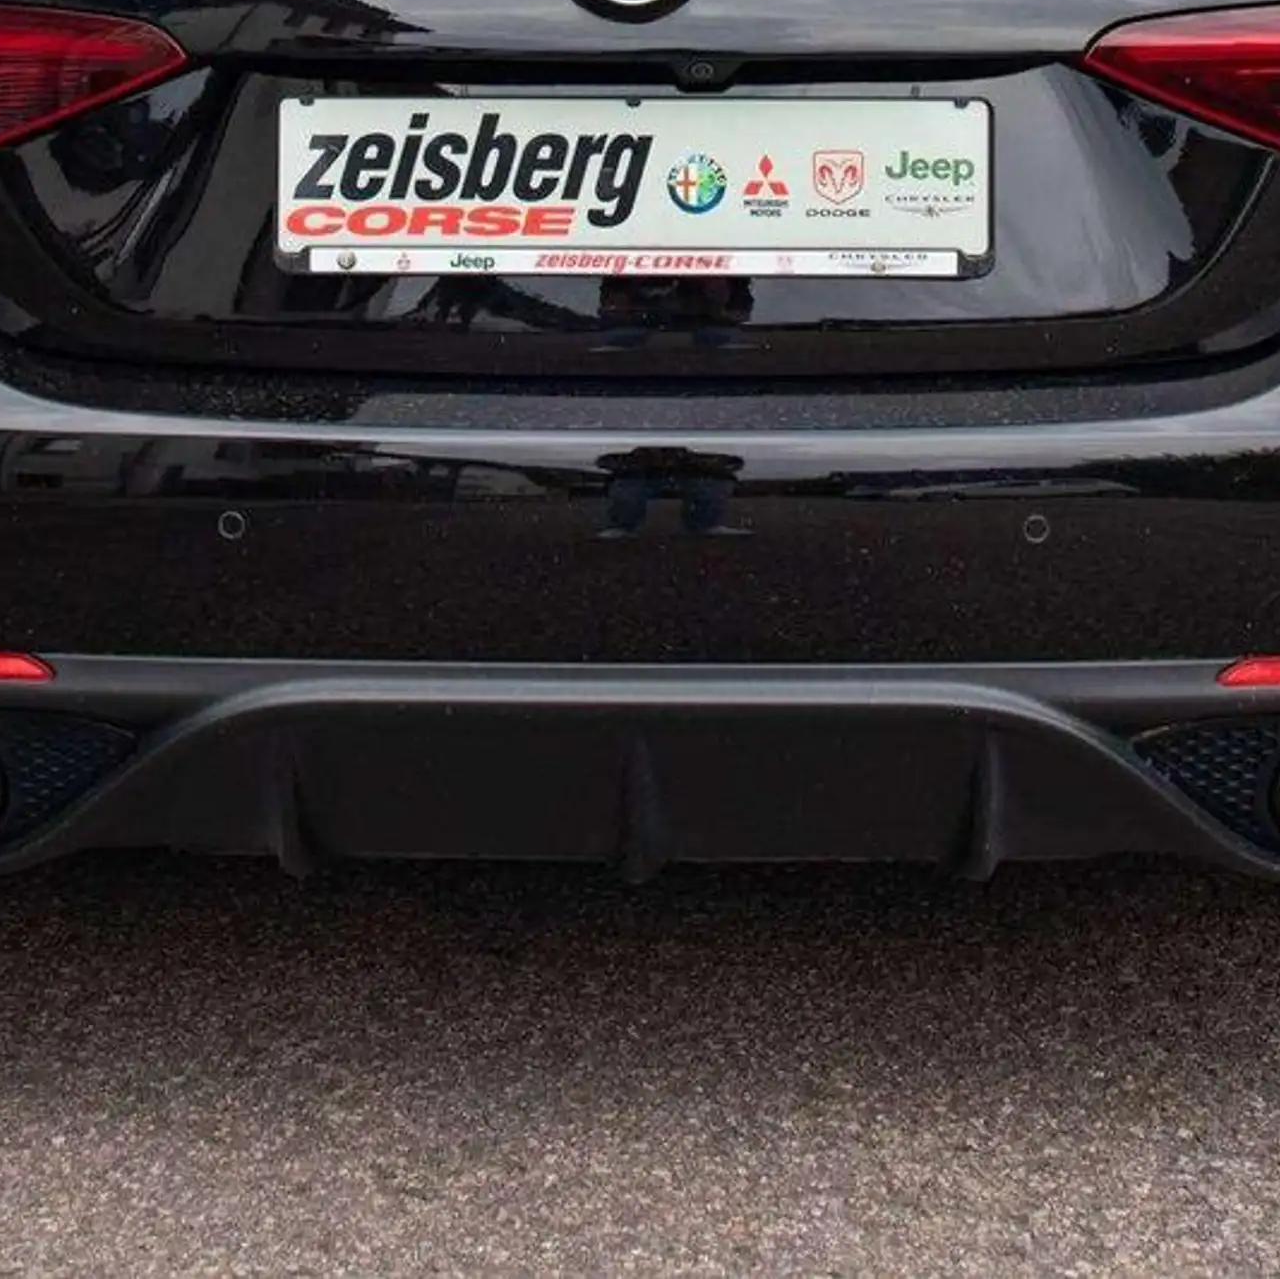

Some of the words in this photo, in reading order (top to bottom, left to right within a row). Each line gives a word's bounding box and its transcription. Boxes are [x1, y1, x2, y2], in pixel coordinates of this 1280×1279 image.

[293, 112, 654, 228] zeisberg
[883, 150, 976, 186] Jeep
[286, 205, 576, 237] CORSE
[805, 208, 871, 218] DODGE
[449, 252, 496, 270] Jeep
